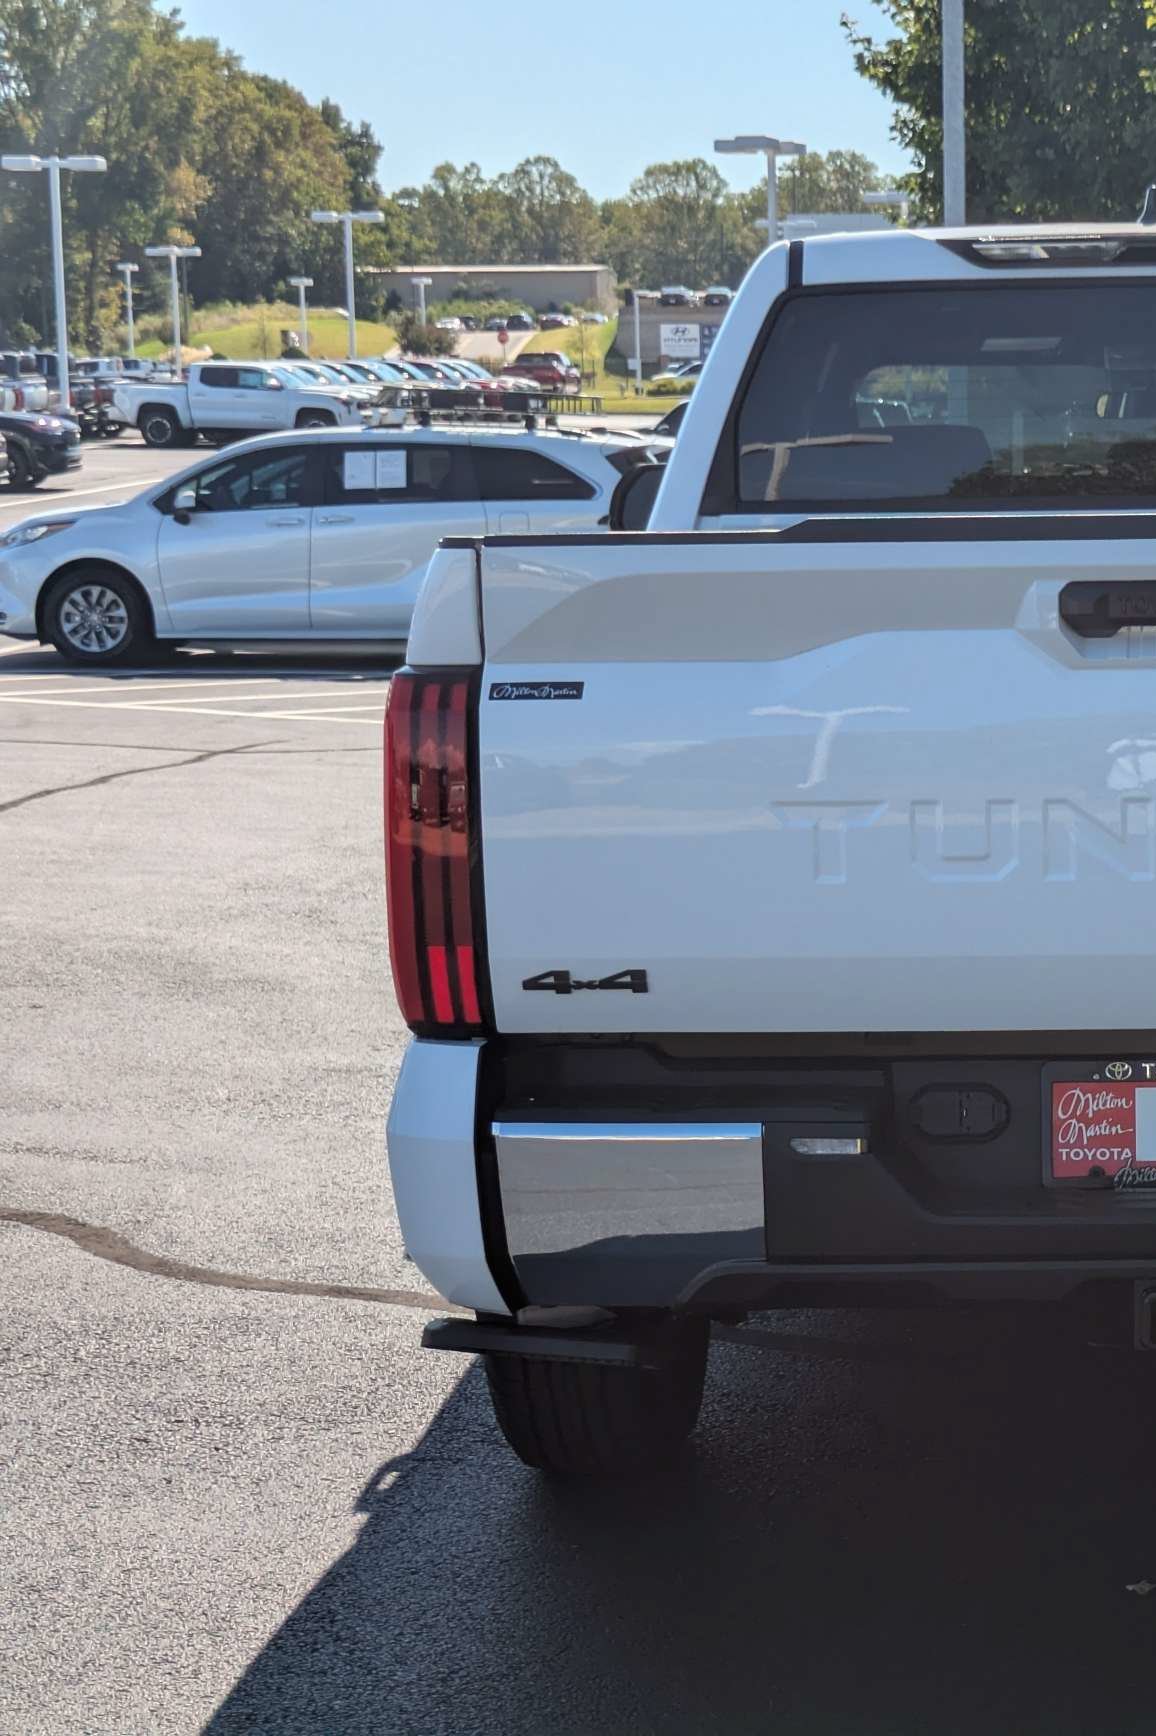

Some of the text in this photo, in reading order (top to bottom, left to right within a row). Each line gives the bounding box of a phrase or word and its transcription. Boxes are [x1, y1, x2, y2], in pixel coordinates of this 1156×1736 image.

[1057, 1087, 1133, 1119] Milton
[1058, 1118, 1133, 1144] Martin
[1058, 1148, 1132, 1161] TOYOTA
